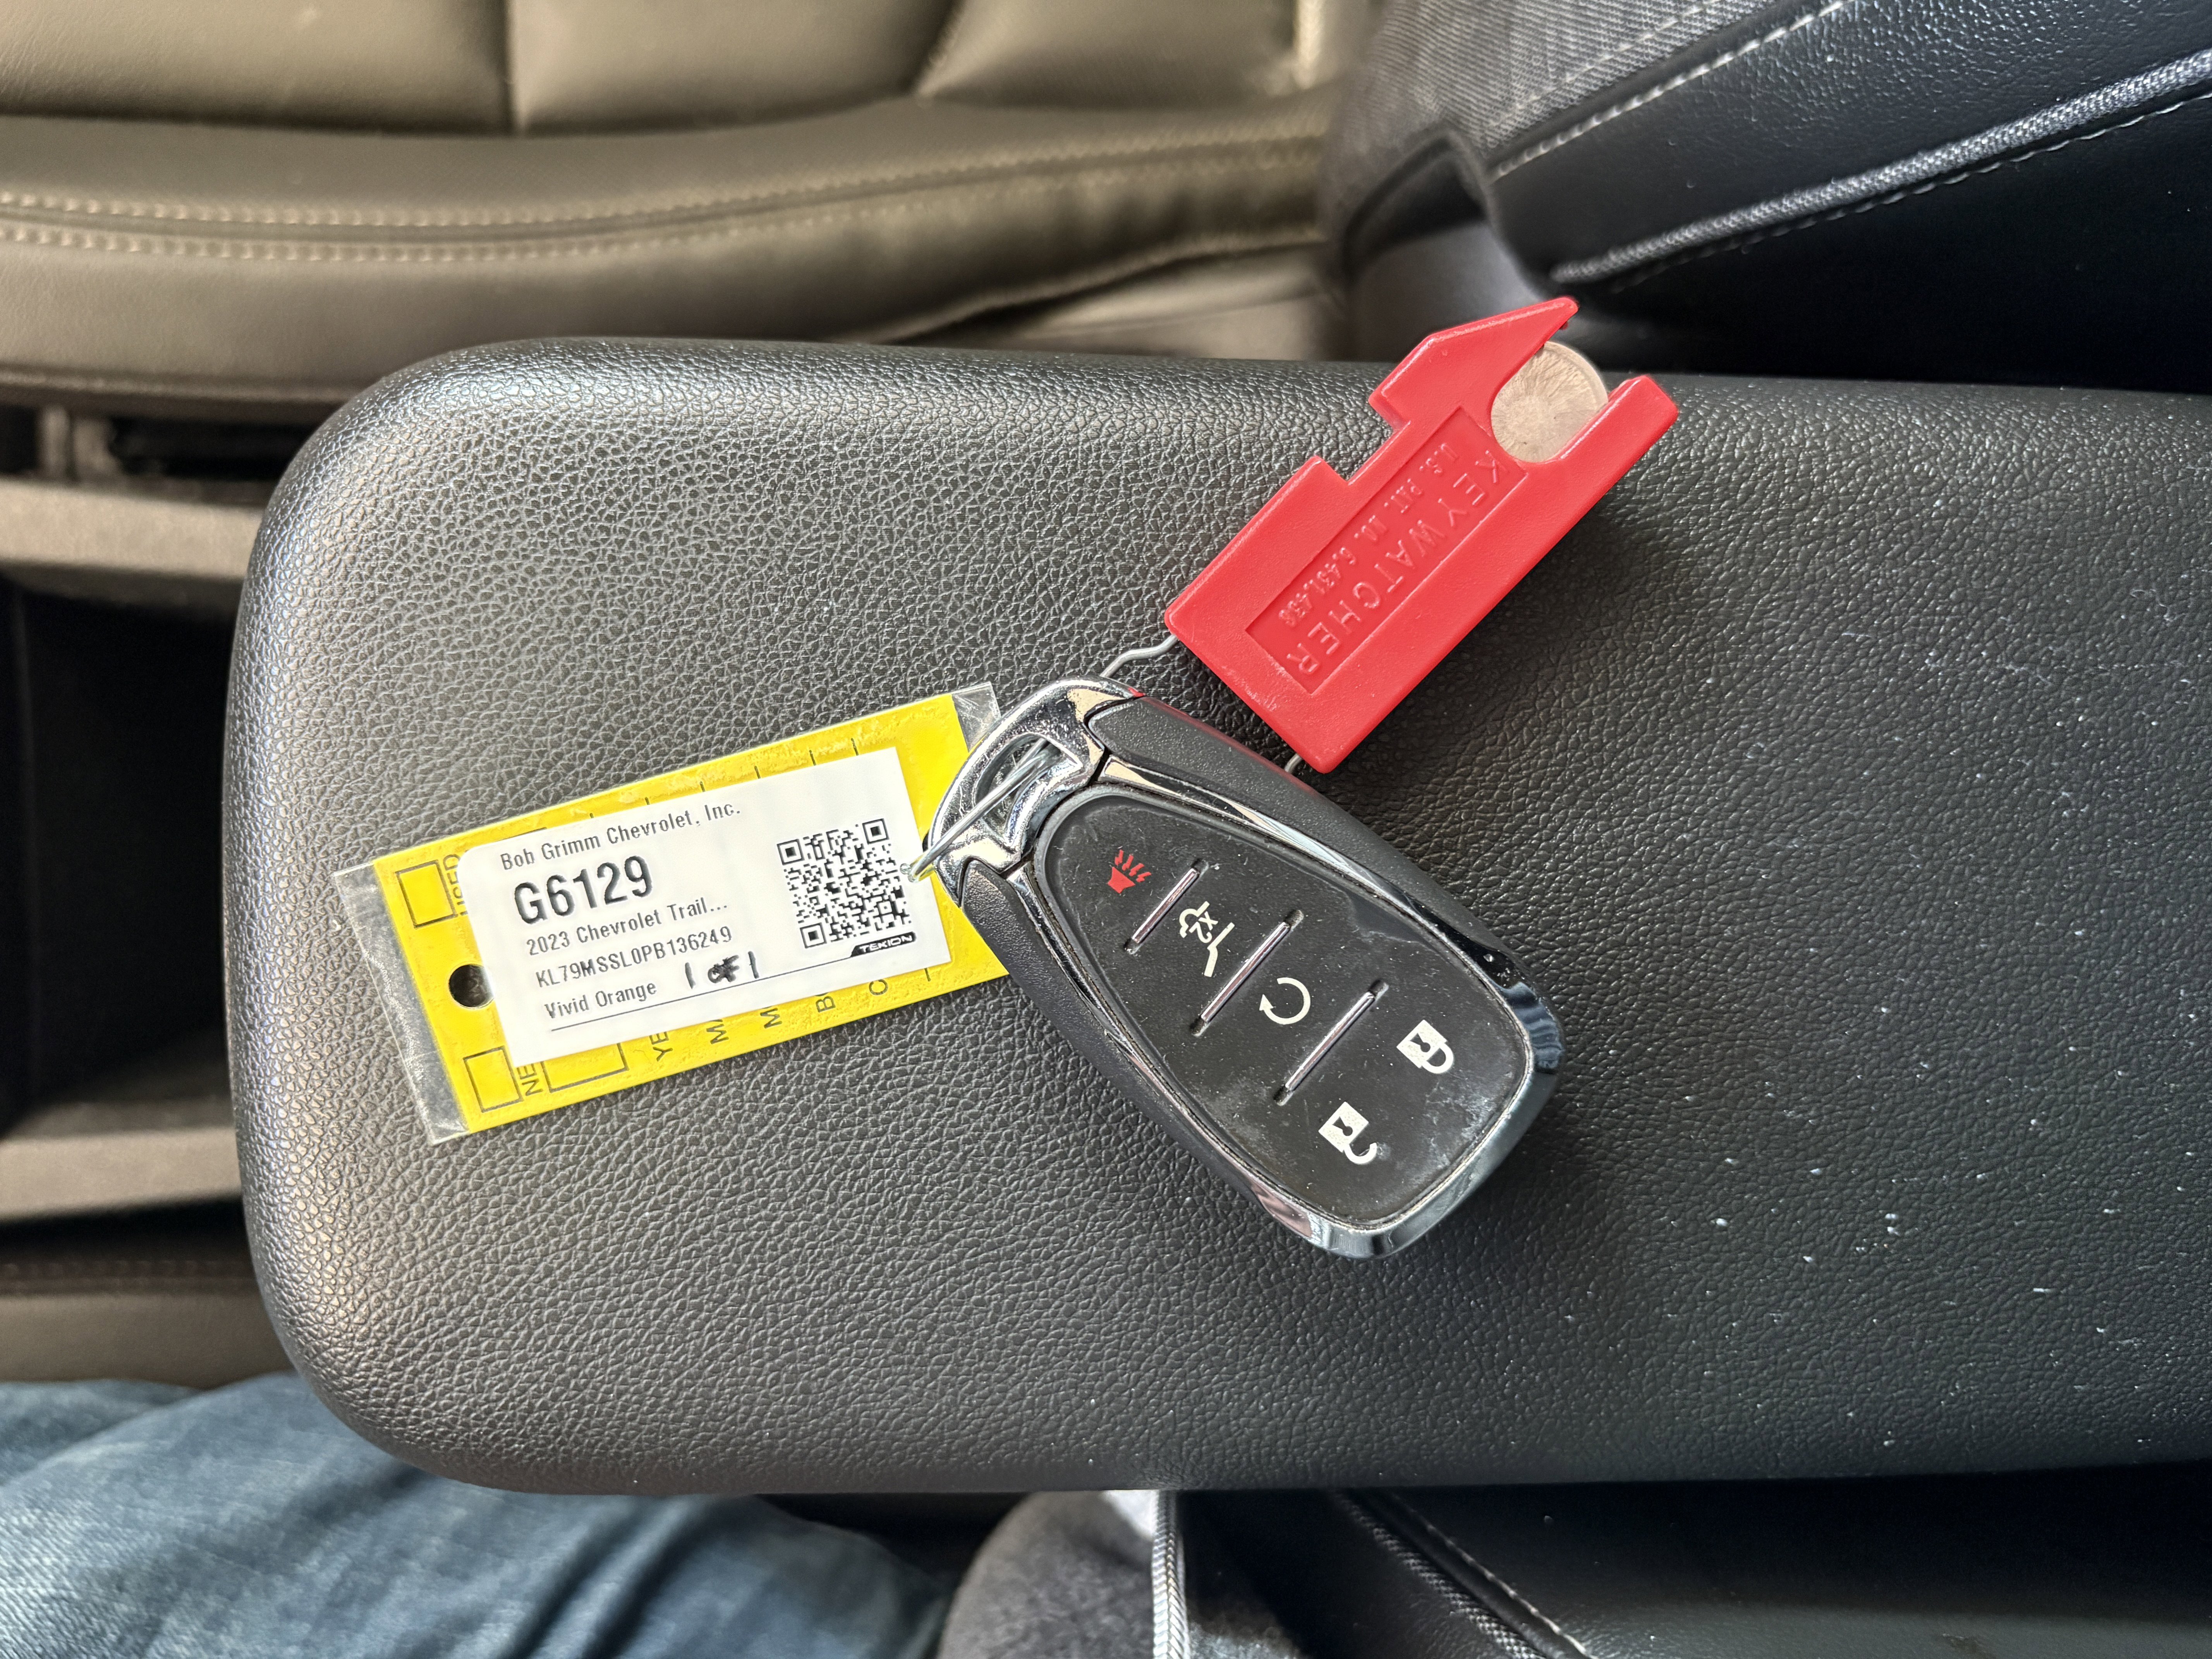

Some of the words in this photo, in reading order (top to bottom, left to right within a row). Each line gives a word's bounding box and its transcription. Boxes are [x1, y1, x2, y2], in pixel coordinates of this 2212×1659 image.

[1419, 443, 1459, 476] U.S.
[1384, 477, 1424, 514] PAT.
[1286, 450, 1506, 673] KEYWATCHER
[501, 849, 534, 869] Bob
[542, 836, 600, 859] Grimm
[607, 811, 699, 843] Chevrolet,
[705, 805, 740, 820] Inc.
[515, 856, 651, 924] G6129
[527, 931, 569, 955] 2023
[577, 910, 661, 943] Chevrolet
[667, 898, 727, 920] Trail...
[859, 934, 913, 953] TEKION
[536, 926, 731, 987] KL79MSSL0PB136249
[544, 995, 588, 1018] Vivid
[596, 983, 655, 1006] Orange
